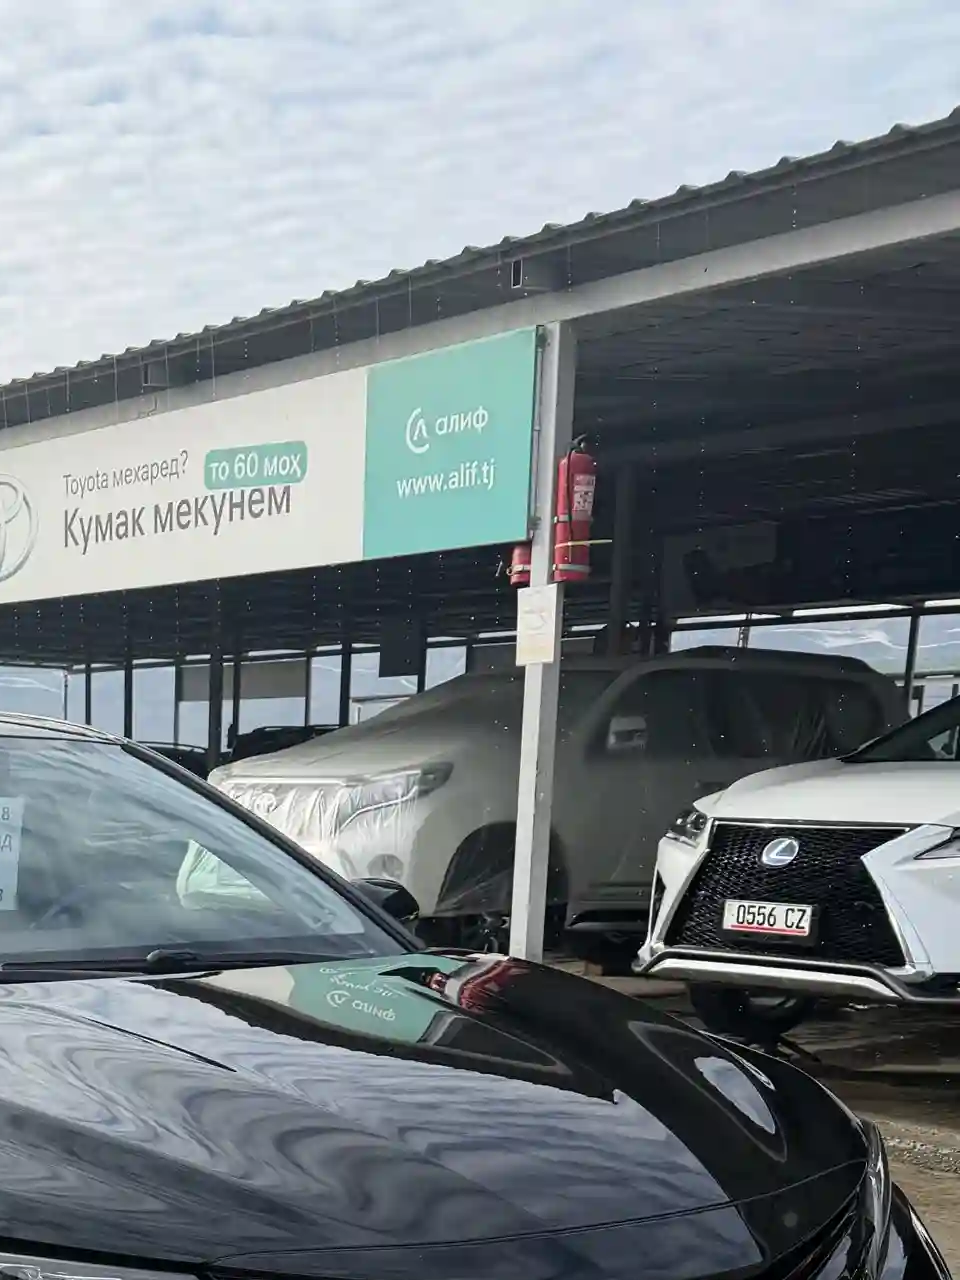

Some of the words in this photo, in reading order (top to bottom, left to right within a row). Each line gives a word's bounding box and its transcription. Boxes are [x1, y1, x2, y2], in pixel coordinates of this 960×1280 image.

[435, 405, 489, 436] алиф
[63, 469, 109, 499] Toyota
[112, 449, 189, 488] мехаред?
[208, 462, 229, 483] то
[233, 452, 258, 480] 60
[396, 457, 495, 499] www.alif.tj
[63, 506, 146, 556] Кумак
[153, 485, 291, 536] мекунем
[736, 904, 777, 927] 0556
[784, 907, 807, 930] CZ
